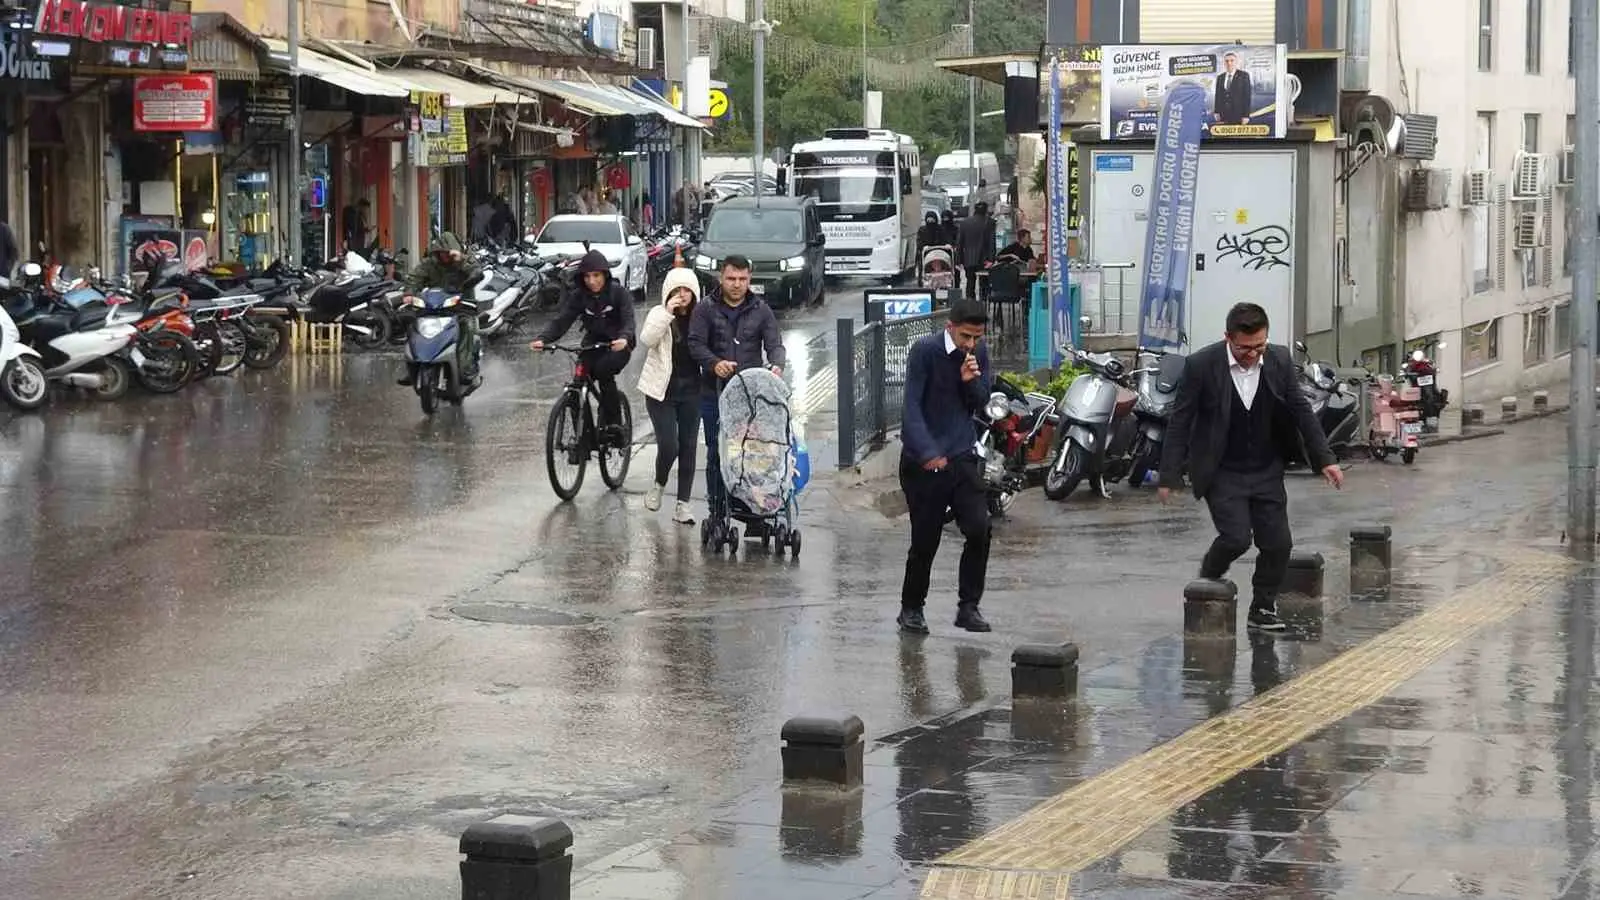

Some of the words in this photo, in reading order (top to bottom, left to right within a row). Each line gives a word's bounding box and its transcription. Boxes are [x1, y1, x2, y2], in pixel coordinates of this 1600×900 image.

[1113, 50, 1161, 64] GÜVENCE
[1113, 64, 1135, 75] BİZİM
[1166, 103, 1184, 149] ADRES
[1159, 152, 1177, 202] DOĞRU
[1176, 142, 1199, 202] SİGORTA
[1149, 206, 1170, 286] SİGORTADA
[1173, 205, 1192, 252] EVRAN
